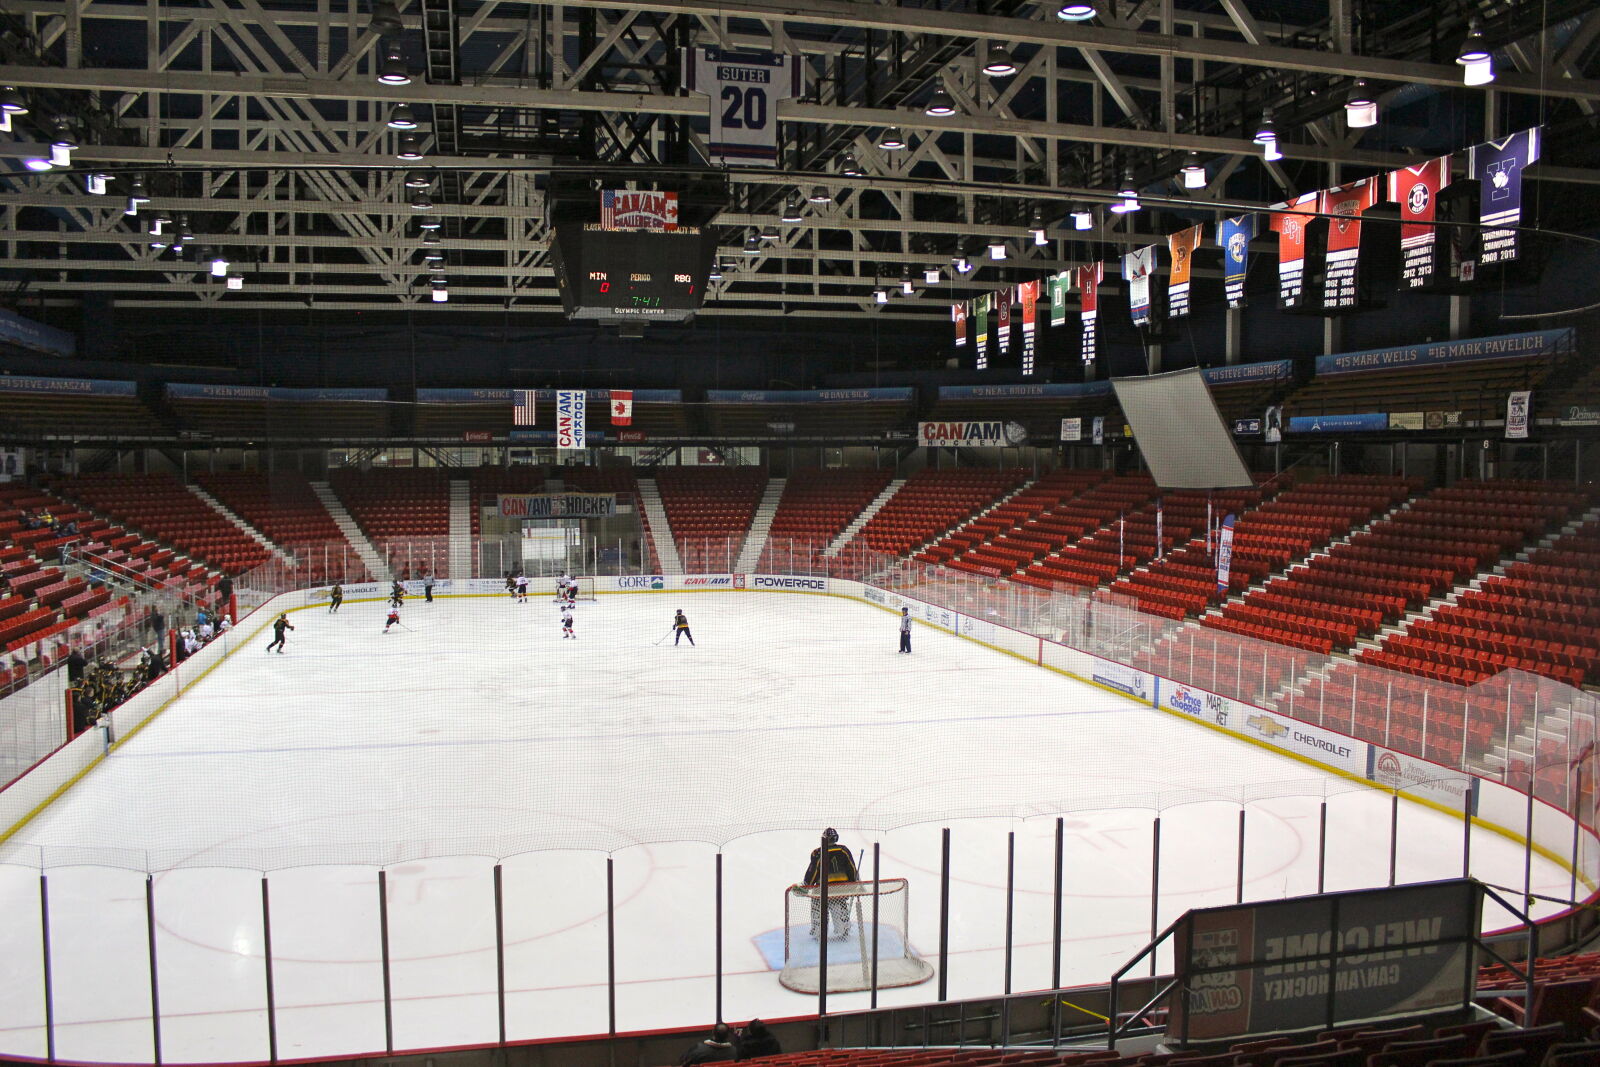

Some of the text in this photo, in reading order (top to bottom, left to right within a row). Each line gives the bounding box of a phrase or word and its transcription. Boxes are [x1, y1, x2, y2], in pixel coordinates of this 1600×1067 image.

[722, 68, 766, 83] SUTER
[721, 86, 767, 130] 20
[613, 193, 667, 220] CAN/AM
[1501, 249, 1515, 260] 2011
[589, 272, 607, 281] MIN
[631, 273, 651, 282] PERIOD
[1403, 268, 1416, 279] 2012
[600, 282, 610, 293] 0
[1410, 277, 1424, 288] 2014
[689, 285, 695, 295] 1
[1335, 335, 1543, 368] #15 MARK WELLS #16 MARK PAVELICH
[1220, 368, 1242, 379] STEVE
[12, 379, 42, 389] STEVE
[488, 391, 511, 399] MIKE
[559, 392, 583, 448] CAN/AM HOCKEY
[923, 422, 1001, 440] CAN/AM
[502, 497, 613, 516] CAN/AM HOCKEY
[618, 576, 650, 588] GORE
[684, 577, 731, 586] CAN/AM
[754, 577, 825, 590] POWERADE
[1183, 691, 1201, 707] Price
[1170, 695, 1201, 716] Chopper
[1294, 731, 1352, 758] CHEVROLET
